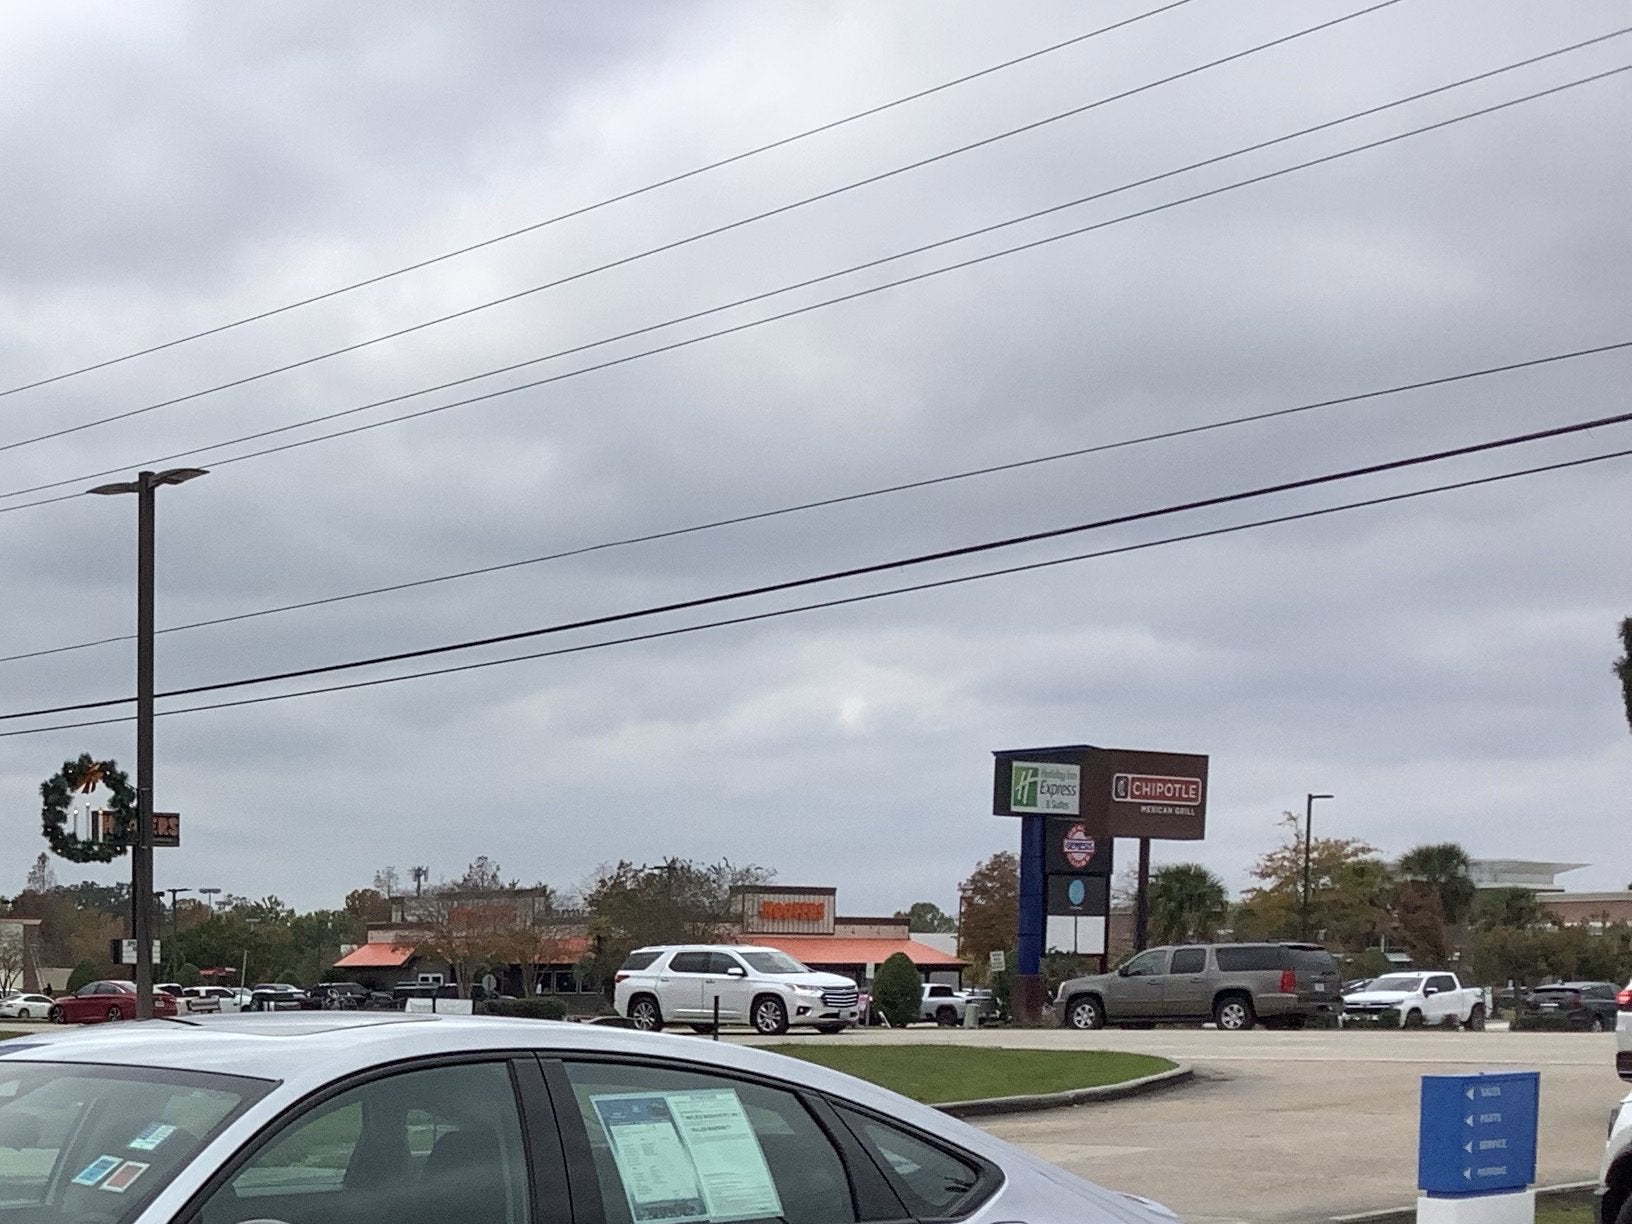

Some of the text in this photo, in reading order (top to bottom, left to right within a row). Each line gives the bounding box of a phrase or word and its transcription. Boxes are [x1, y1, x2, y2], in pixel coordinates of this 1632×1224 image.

[1040, 780, 1077, 798] Express
[1132, 781, 1198, 798] CHIPOTLE
[1140, 805, 1196, 816] MEXICAN GRILL
